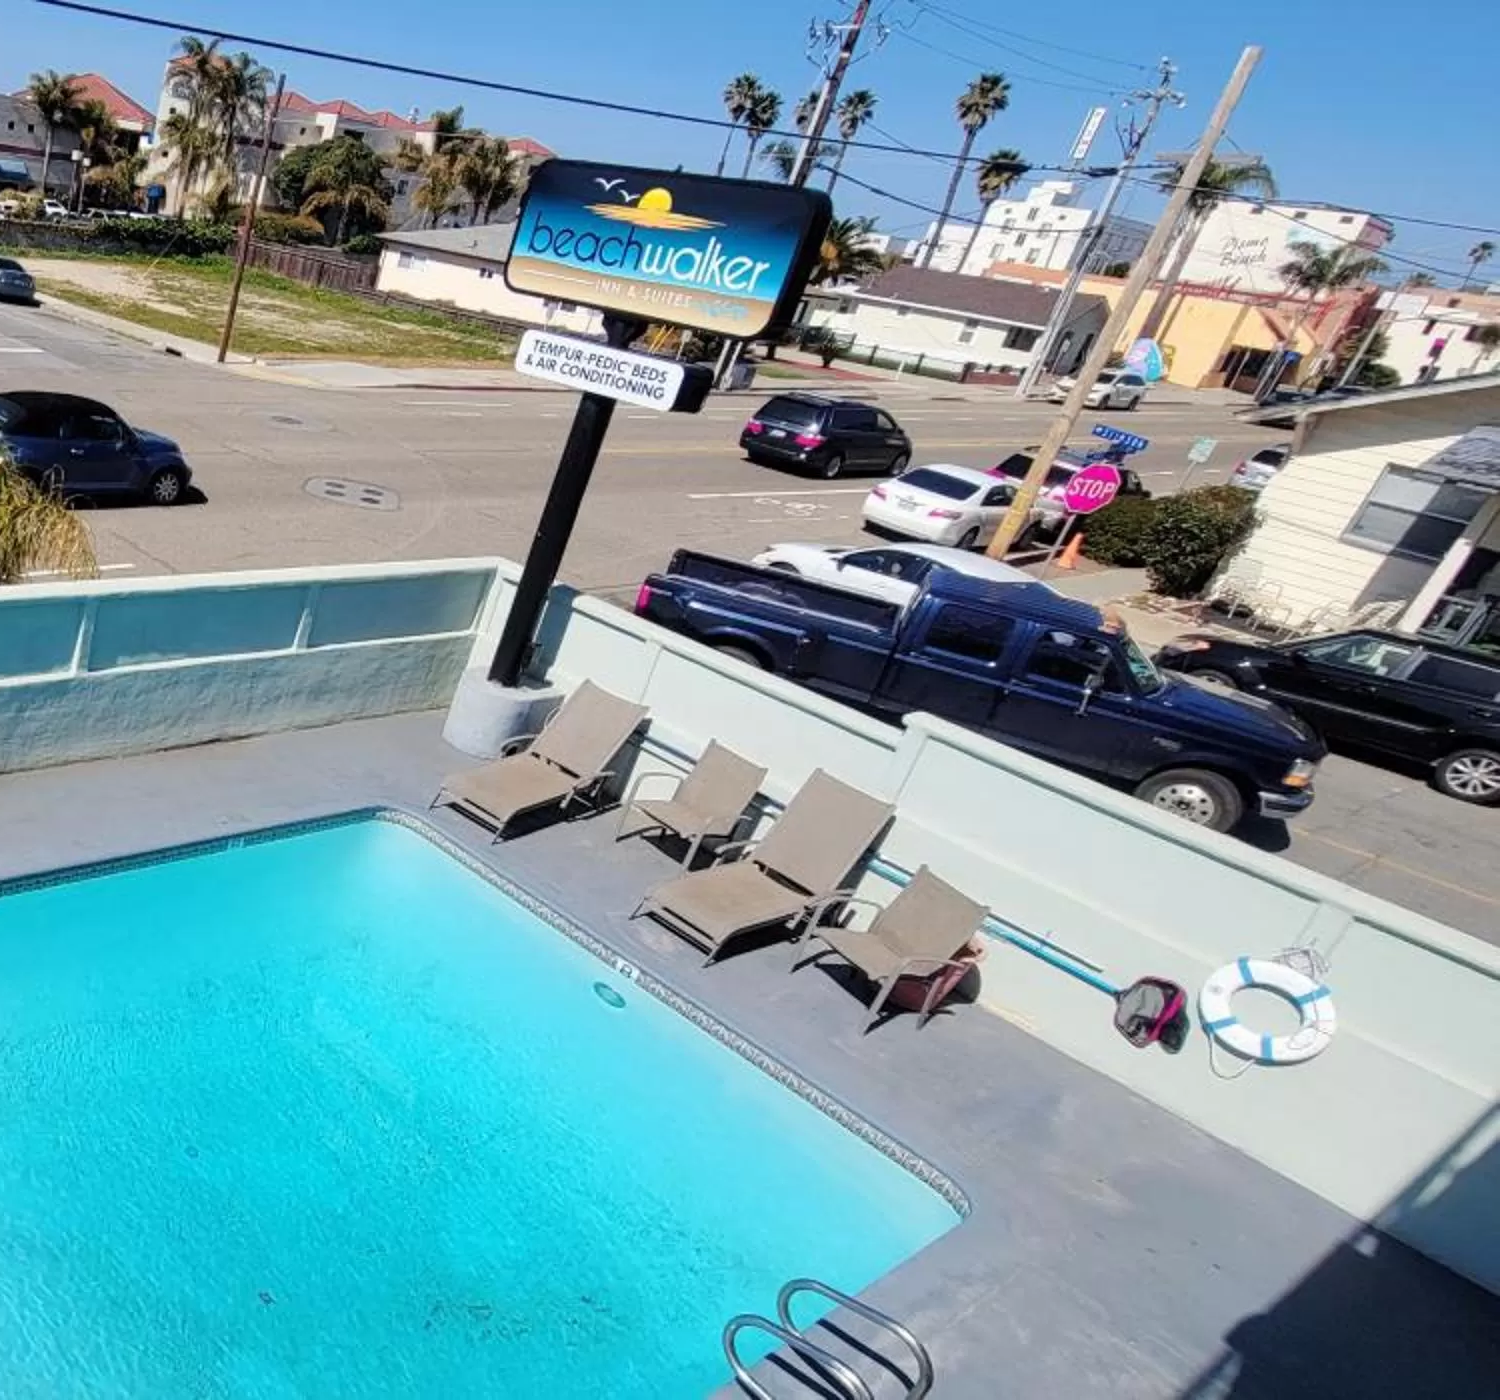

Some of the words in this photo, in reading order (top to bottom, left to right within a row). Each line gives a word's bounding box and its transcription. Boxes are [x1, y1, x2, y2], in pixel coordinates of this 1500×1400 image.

[528, 211, 770, 292] beachwalker
[595, 279, 621, 294] INN
[642, 287, 692, 308] SUITES
[523, 353, 533, 365] &
[535, 356, 556, 372] AIR
[559, 363, 665, 400] CONDITIONING
[631, 365, 668, 385] BEDS
[1068, 477, 1116, 498] STOP
